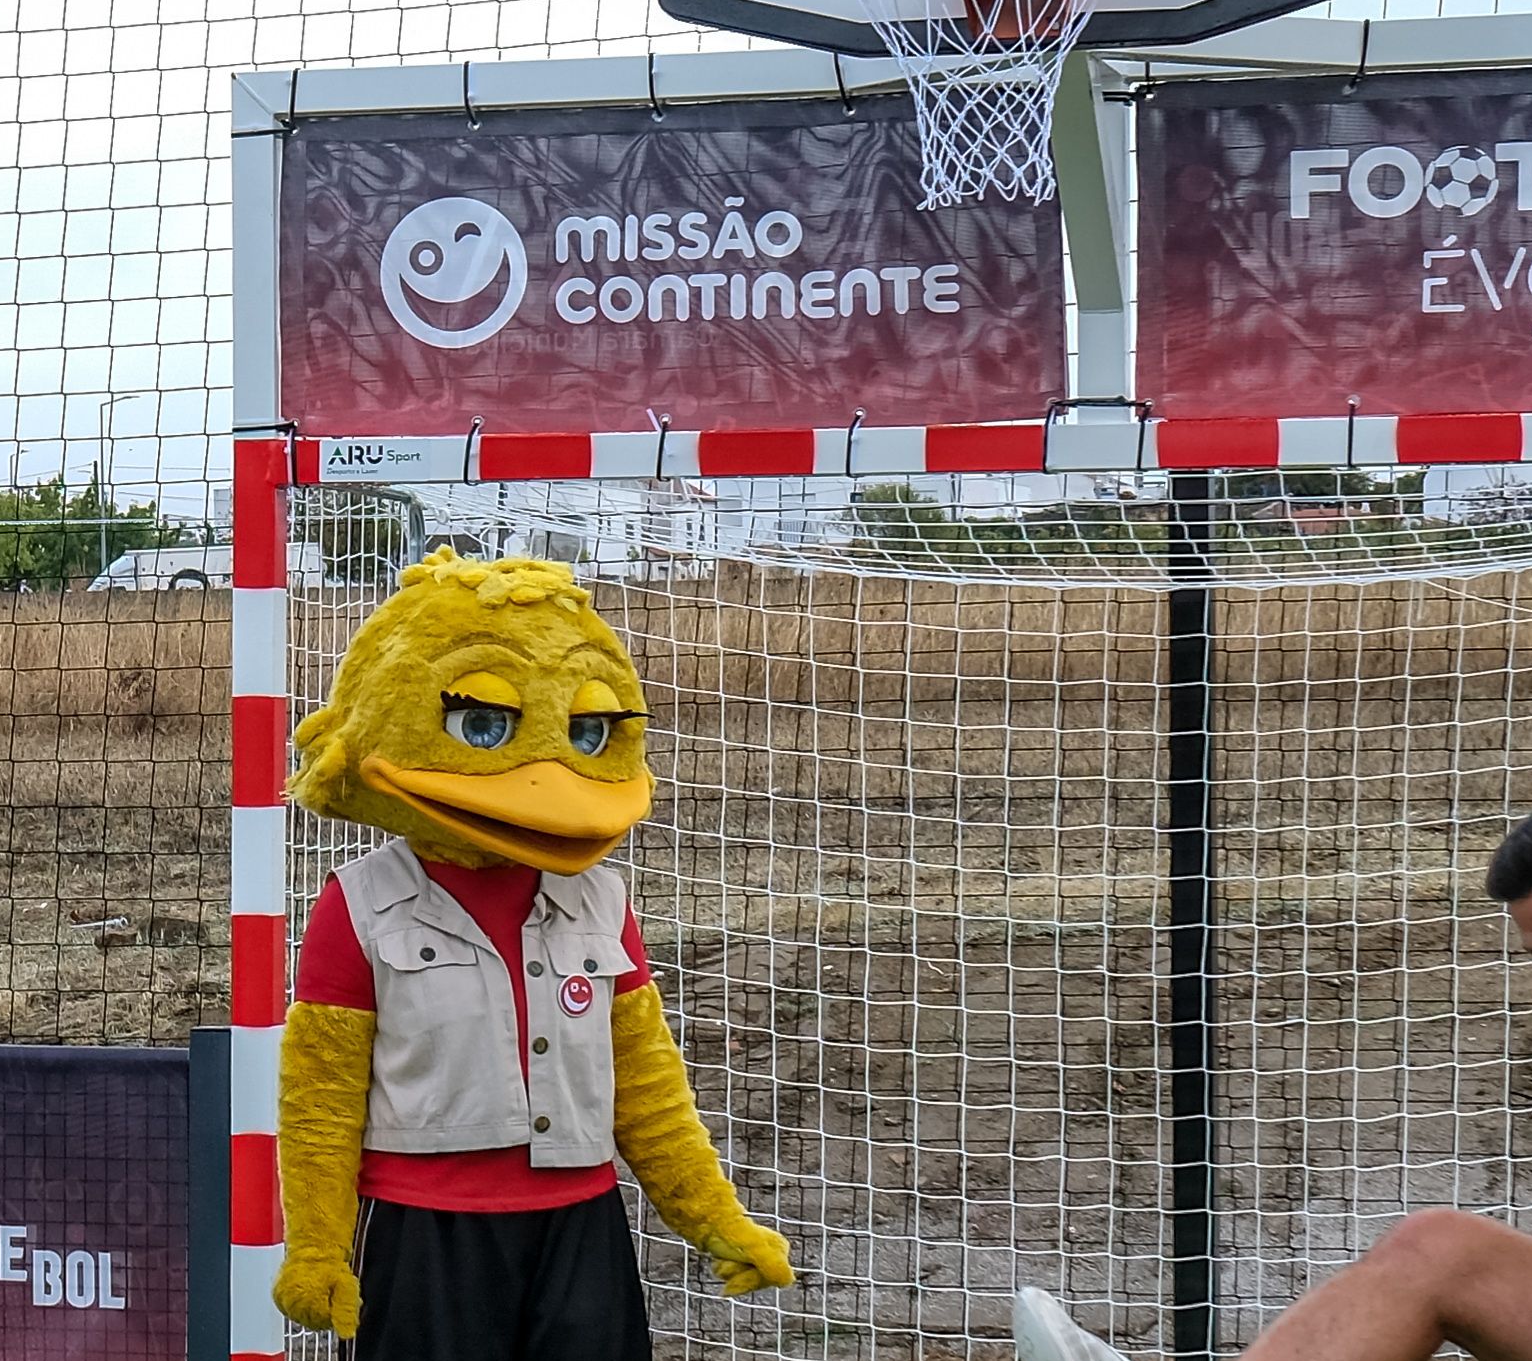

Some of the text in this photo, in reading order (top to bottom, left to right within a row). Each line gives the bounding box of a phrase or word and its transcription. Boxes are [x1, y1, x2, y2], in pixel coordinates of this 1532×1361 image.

[555, 196, 803, 264] MISSÃO
[555, 264, 960, 325] CONTINENTE
[328, 445, 421, 465] ARU Sport
